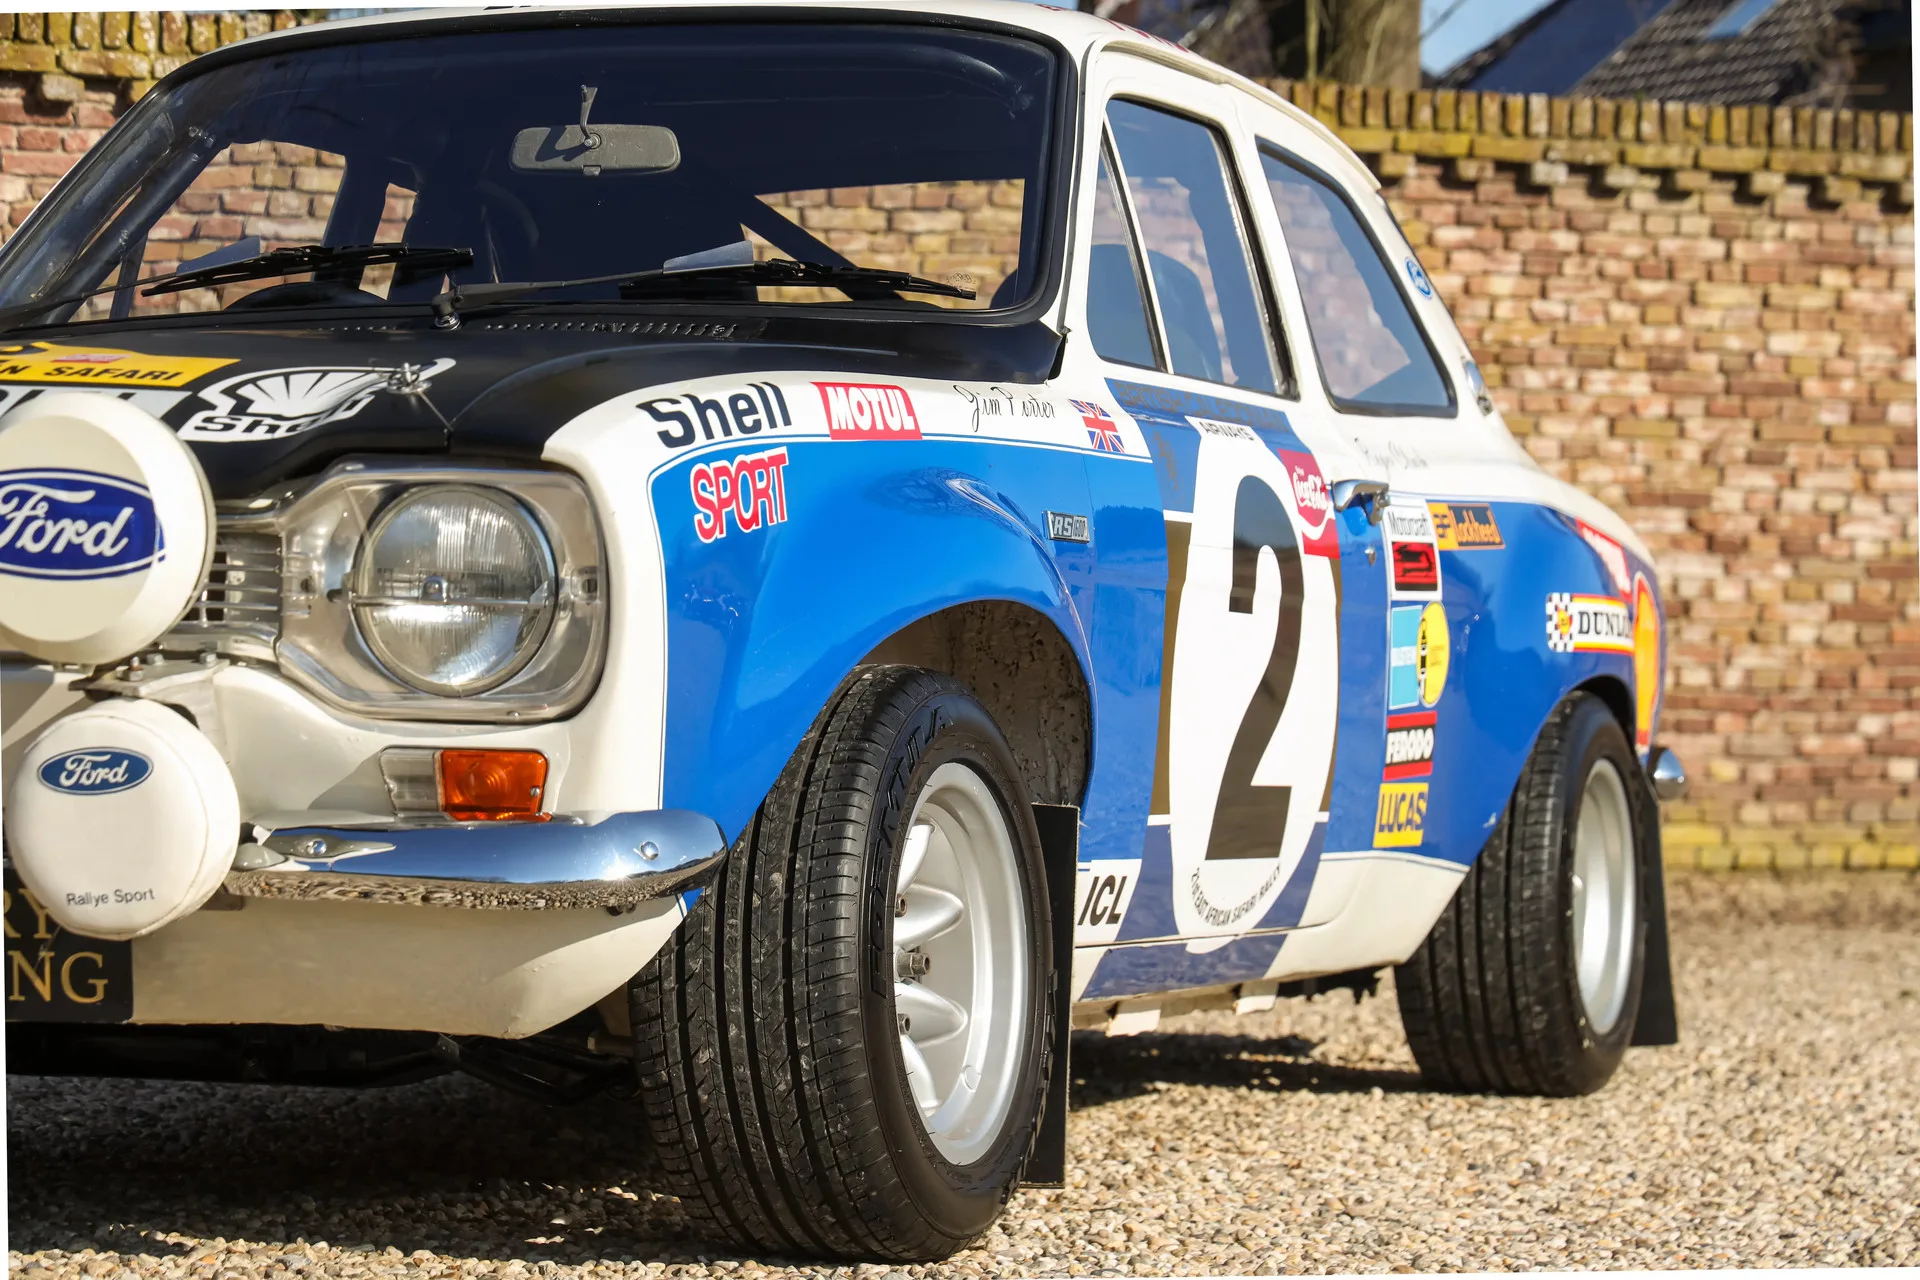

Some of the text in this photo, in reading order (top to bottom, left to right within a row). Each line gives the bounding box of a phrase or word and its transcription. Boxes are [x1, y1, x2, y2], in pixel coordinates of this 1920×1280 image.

[44, 366, 184, 381] SAFARI
[635, 382, 793, 448] Shell
[827, 386, 917, 432] MOTUL
[953, 385, 1056, 432] Jim Porter
[1198, 421, 1255, 441] AIRWAYS
[690, 446, 789, 544] SPORT
[0, 483, 135, 558] Ford
[1447, 508, 1502, 544] Lockheed
[1203, 475, 1304, 860] 2
[1384, 727, 1434, 765] FERODO
[58, 753, 130, 788] Ford
[1378, 792, 1429, 833] LUCAS
[66, 888, 155, 907] Rallye Sport
[1077, 875, 1128, 927] ICL
